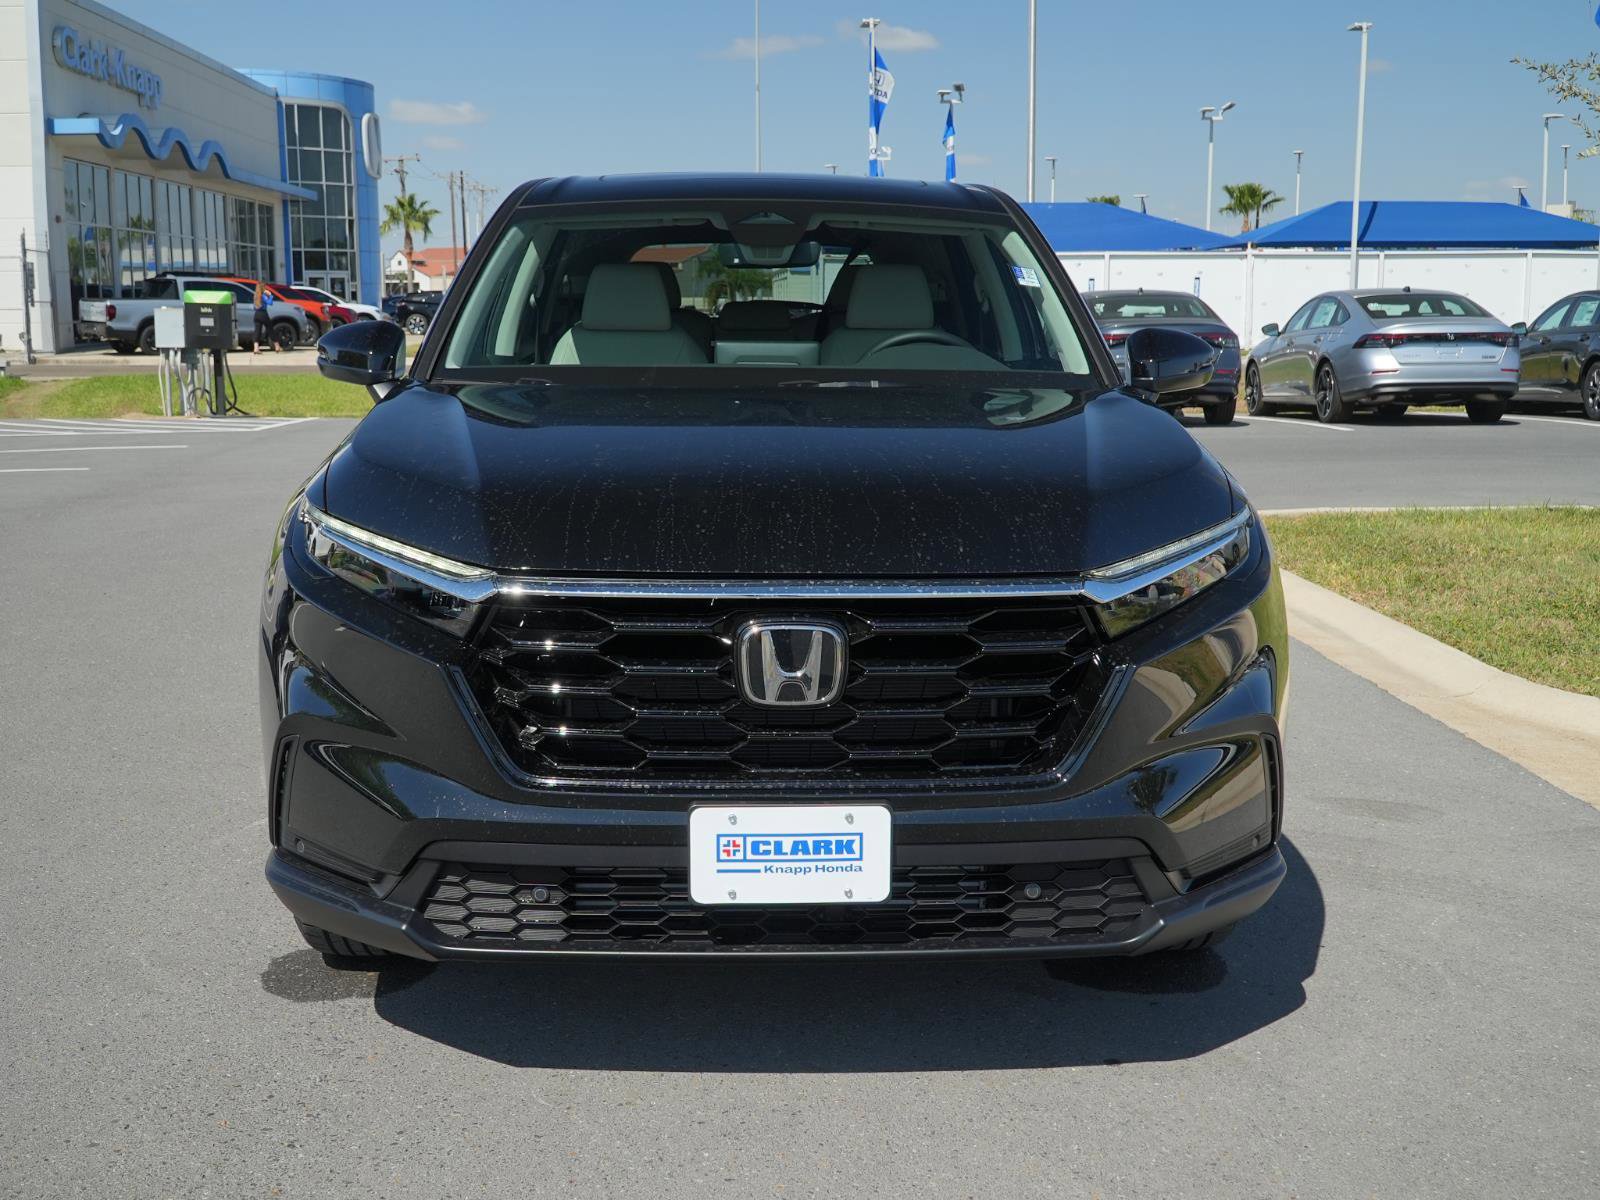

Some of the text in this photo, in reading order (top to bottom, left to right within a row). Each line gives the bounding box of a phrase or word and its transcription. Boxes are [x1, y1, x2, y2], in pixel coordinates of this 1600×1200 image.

[751, 839, 856, 856] CLARK
[764, 864, 863, 875] Knapp Honda
